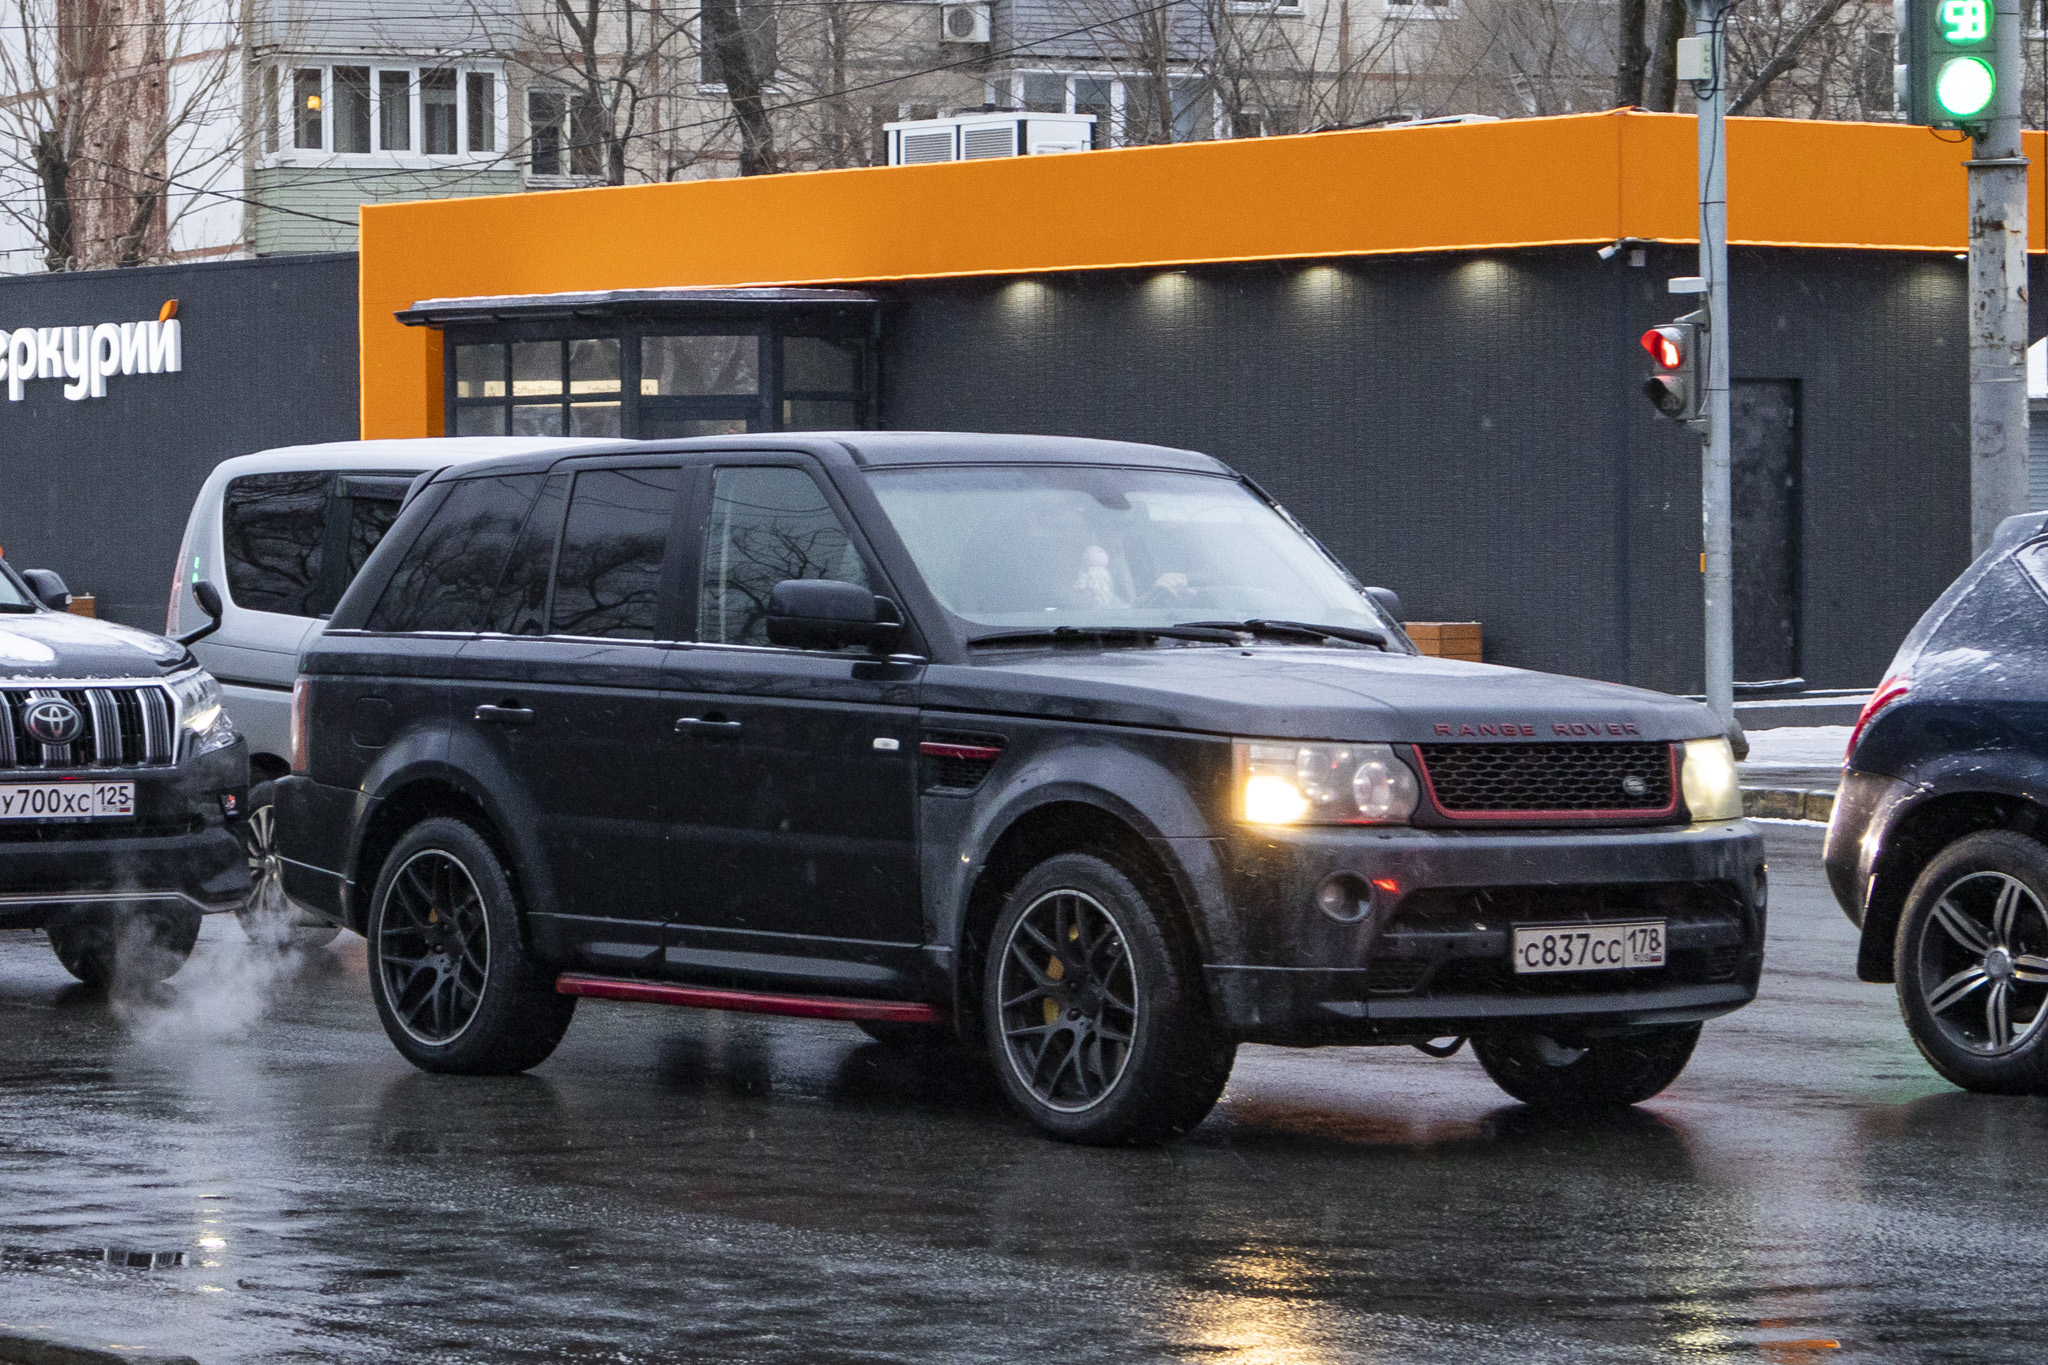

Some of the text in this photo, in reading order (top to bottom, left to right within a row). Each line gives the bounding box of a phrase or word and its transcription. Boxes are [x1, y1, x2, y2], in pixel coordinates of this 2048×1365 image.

[1944, 0, 1987, 39] 58
[1434, 723, 1640, 737] RANGE ROVER
[2, 785, 129, 815] У700ХС 125
[1524, 928, 1660, 967] С837СС 178
